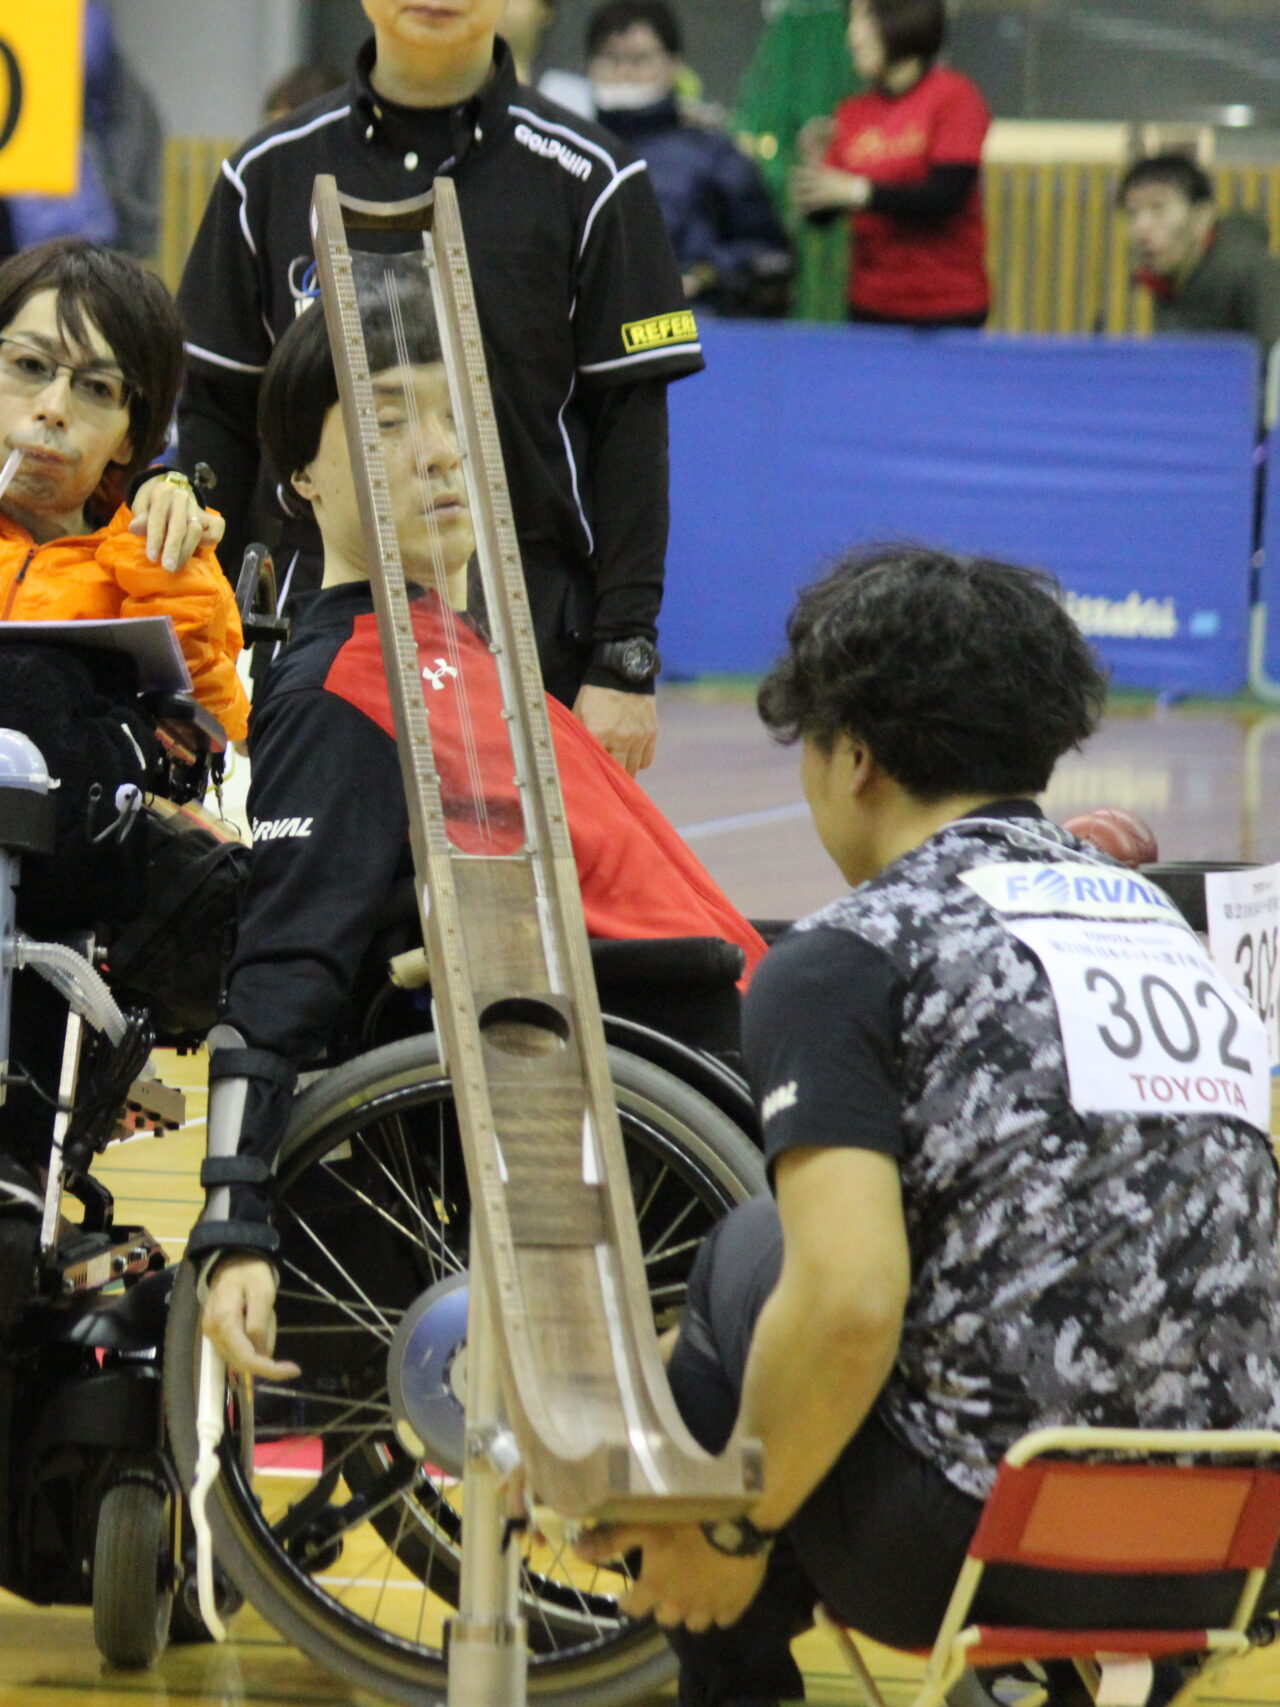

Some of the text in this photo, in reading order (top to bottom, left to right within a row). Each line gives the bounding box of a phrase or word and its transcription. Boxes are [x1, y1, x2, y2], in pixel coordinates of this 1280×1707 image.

[514, 124, 593, 182] GOLDWIN
[1085, 967, 1252, 1075] 302
[1129, 1073, 1248, 1111] TOYOTA
